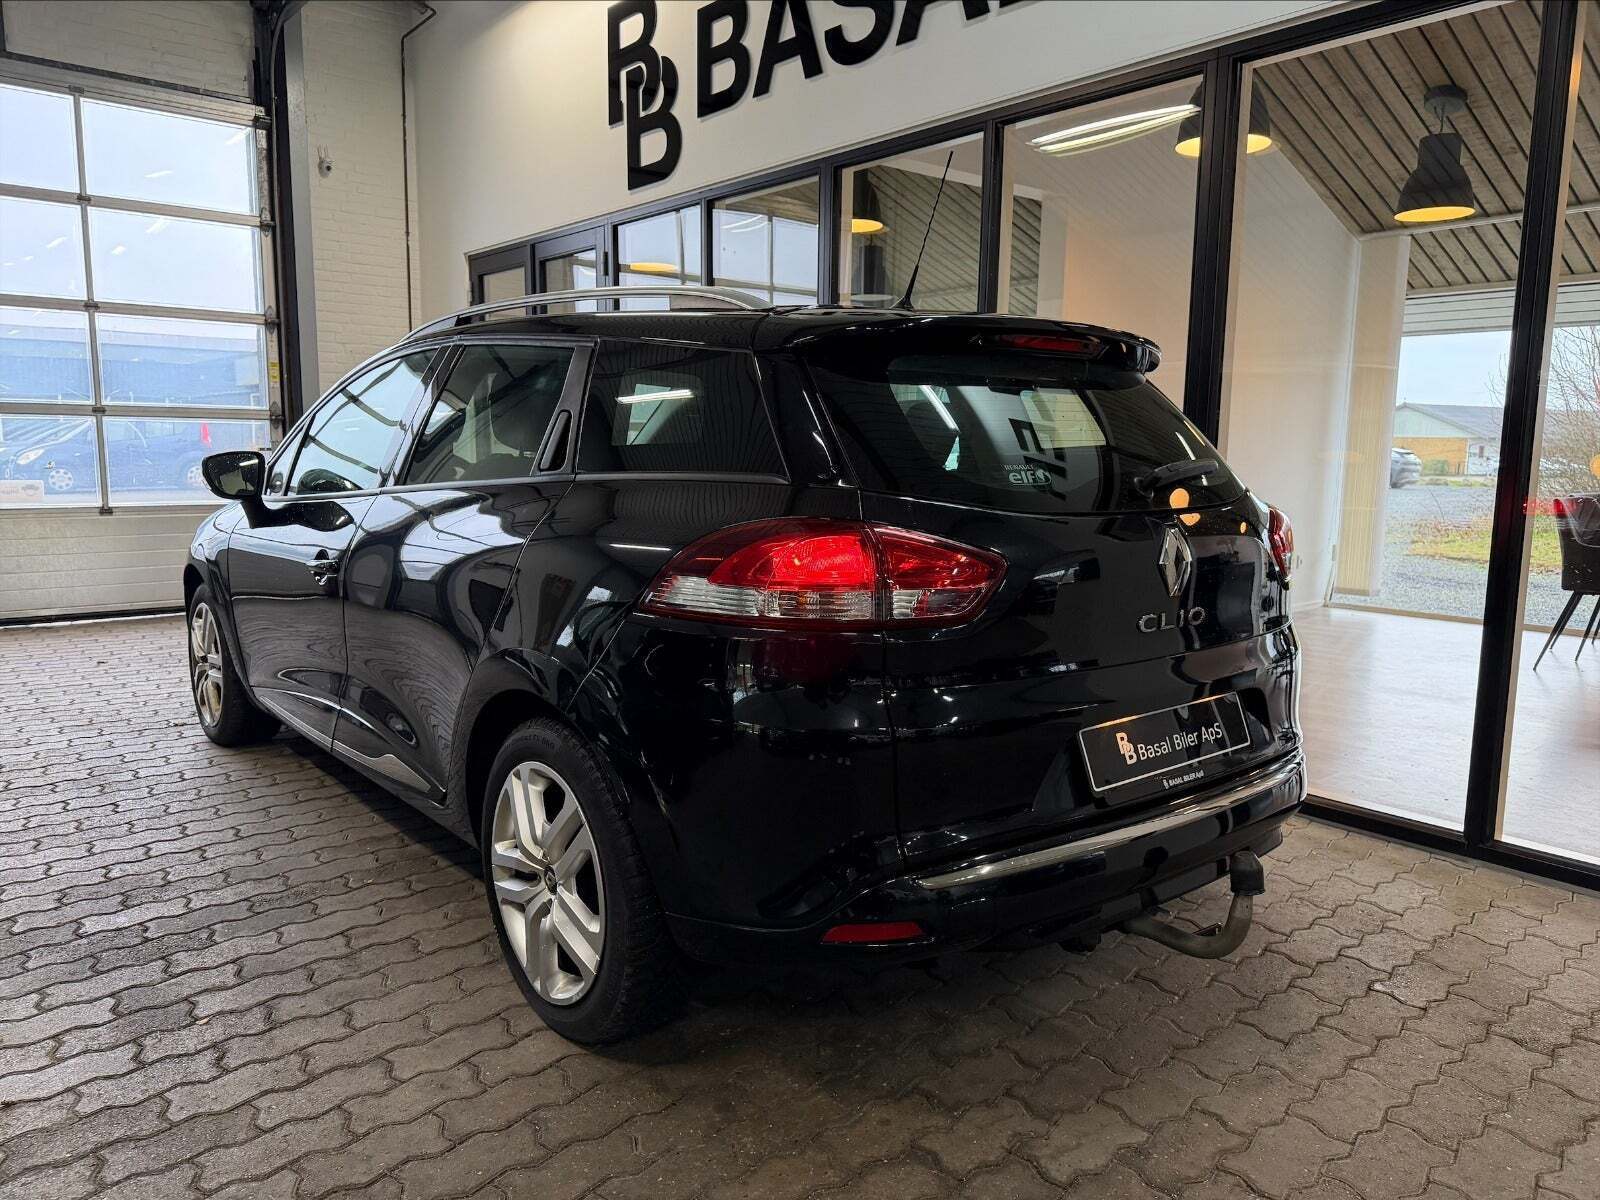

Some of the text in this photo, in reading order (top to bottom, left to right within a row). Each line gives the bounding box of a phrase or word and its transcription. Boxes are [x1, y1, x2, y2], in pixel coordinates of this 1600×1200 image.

[697, 0, 1024, 118] BAS
[1138, 606, 1206, 633] CLIO
[1137, 736, 1172, 761] Basal
[1173, 731, 1198, 751] Biler
[1201, 722, 1223, 744] ApS
